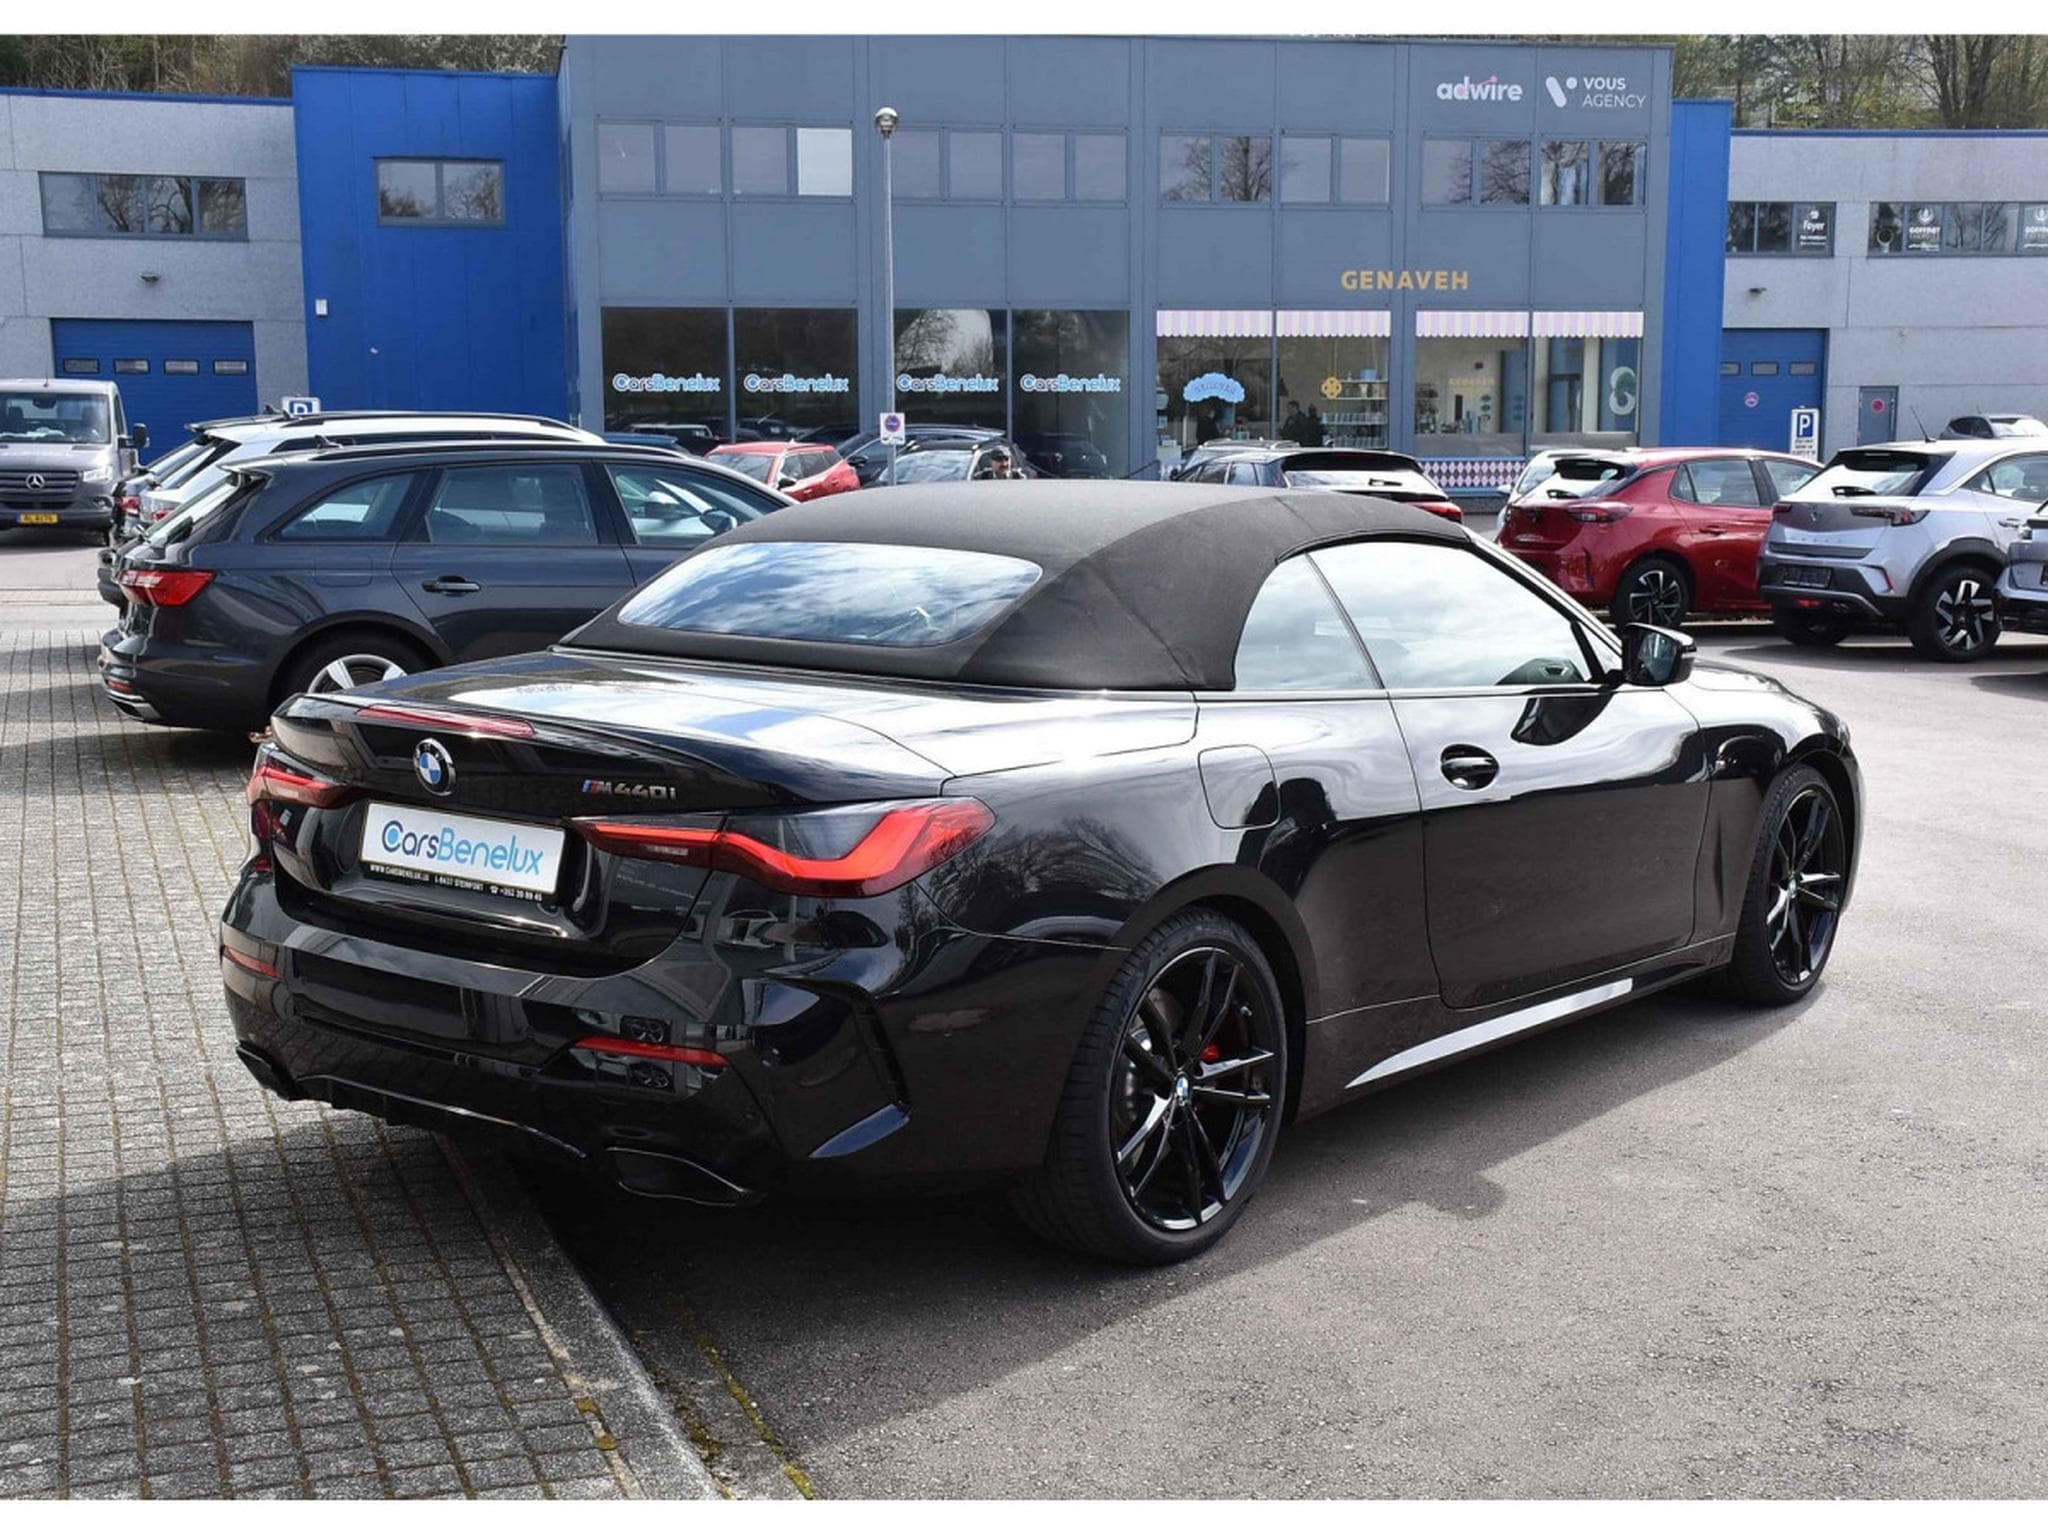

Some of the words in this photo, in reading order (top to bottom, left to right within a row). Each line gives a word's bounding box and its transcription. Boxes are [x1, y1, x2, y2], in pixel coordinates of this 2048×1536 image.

[1436, 75, 1523, 101] adwire
[1583, 76, 1626, 91] VOUS
[1581, 93, 1647, 109] AGENCY
[1340, 270, 1470, 291] GENAVEH
[612, 372, 721, 393] CarsBenelux
[743, 372, 849, 393] CarsBenelux
[896, 372, 999, 393] CarsBenelux
[1020, 372, 1121, 393] CarsBenelux
[1799, 414, 1811, 436] P
[382, 820, 544, 876] CarsBenelux
